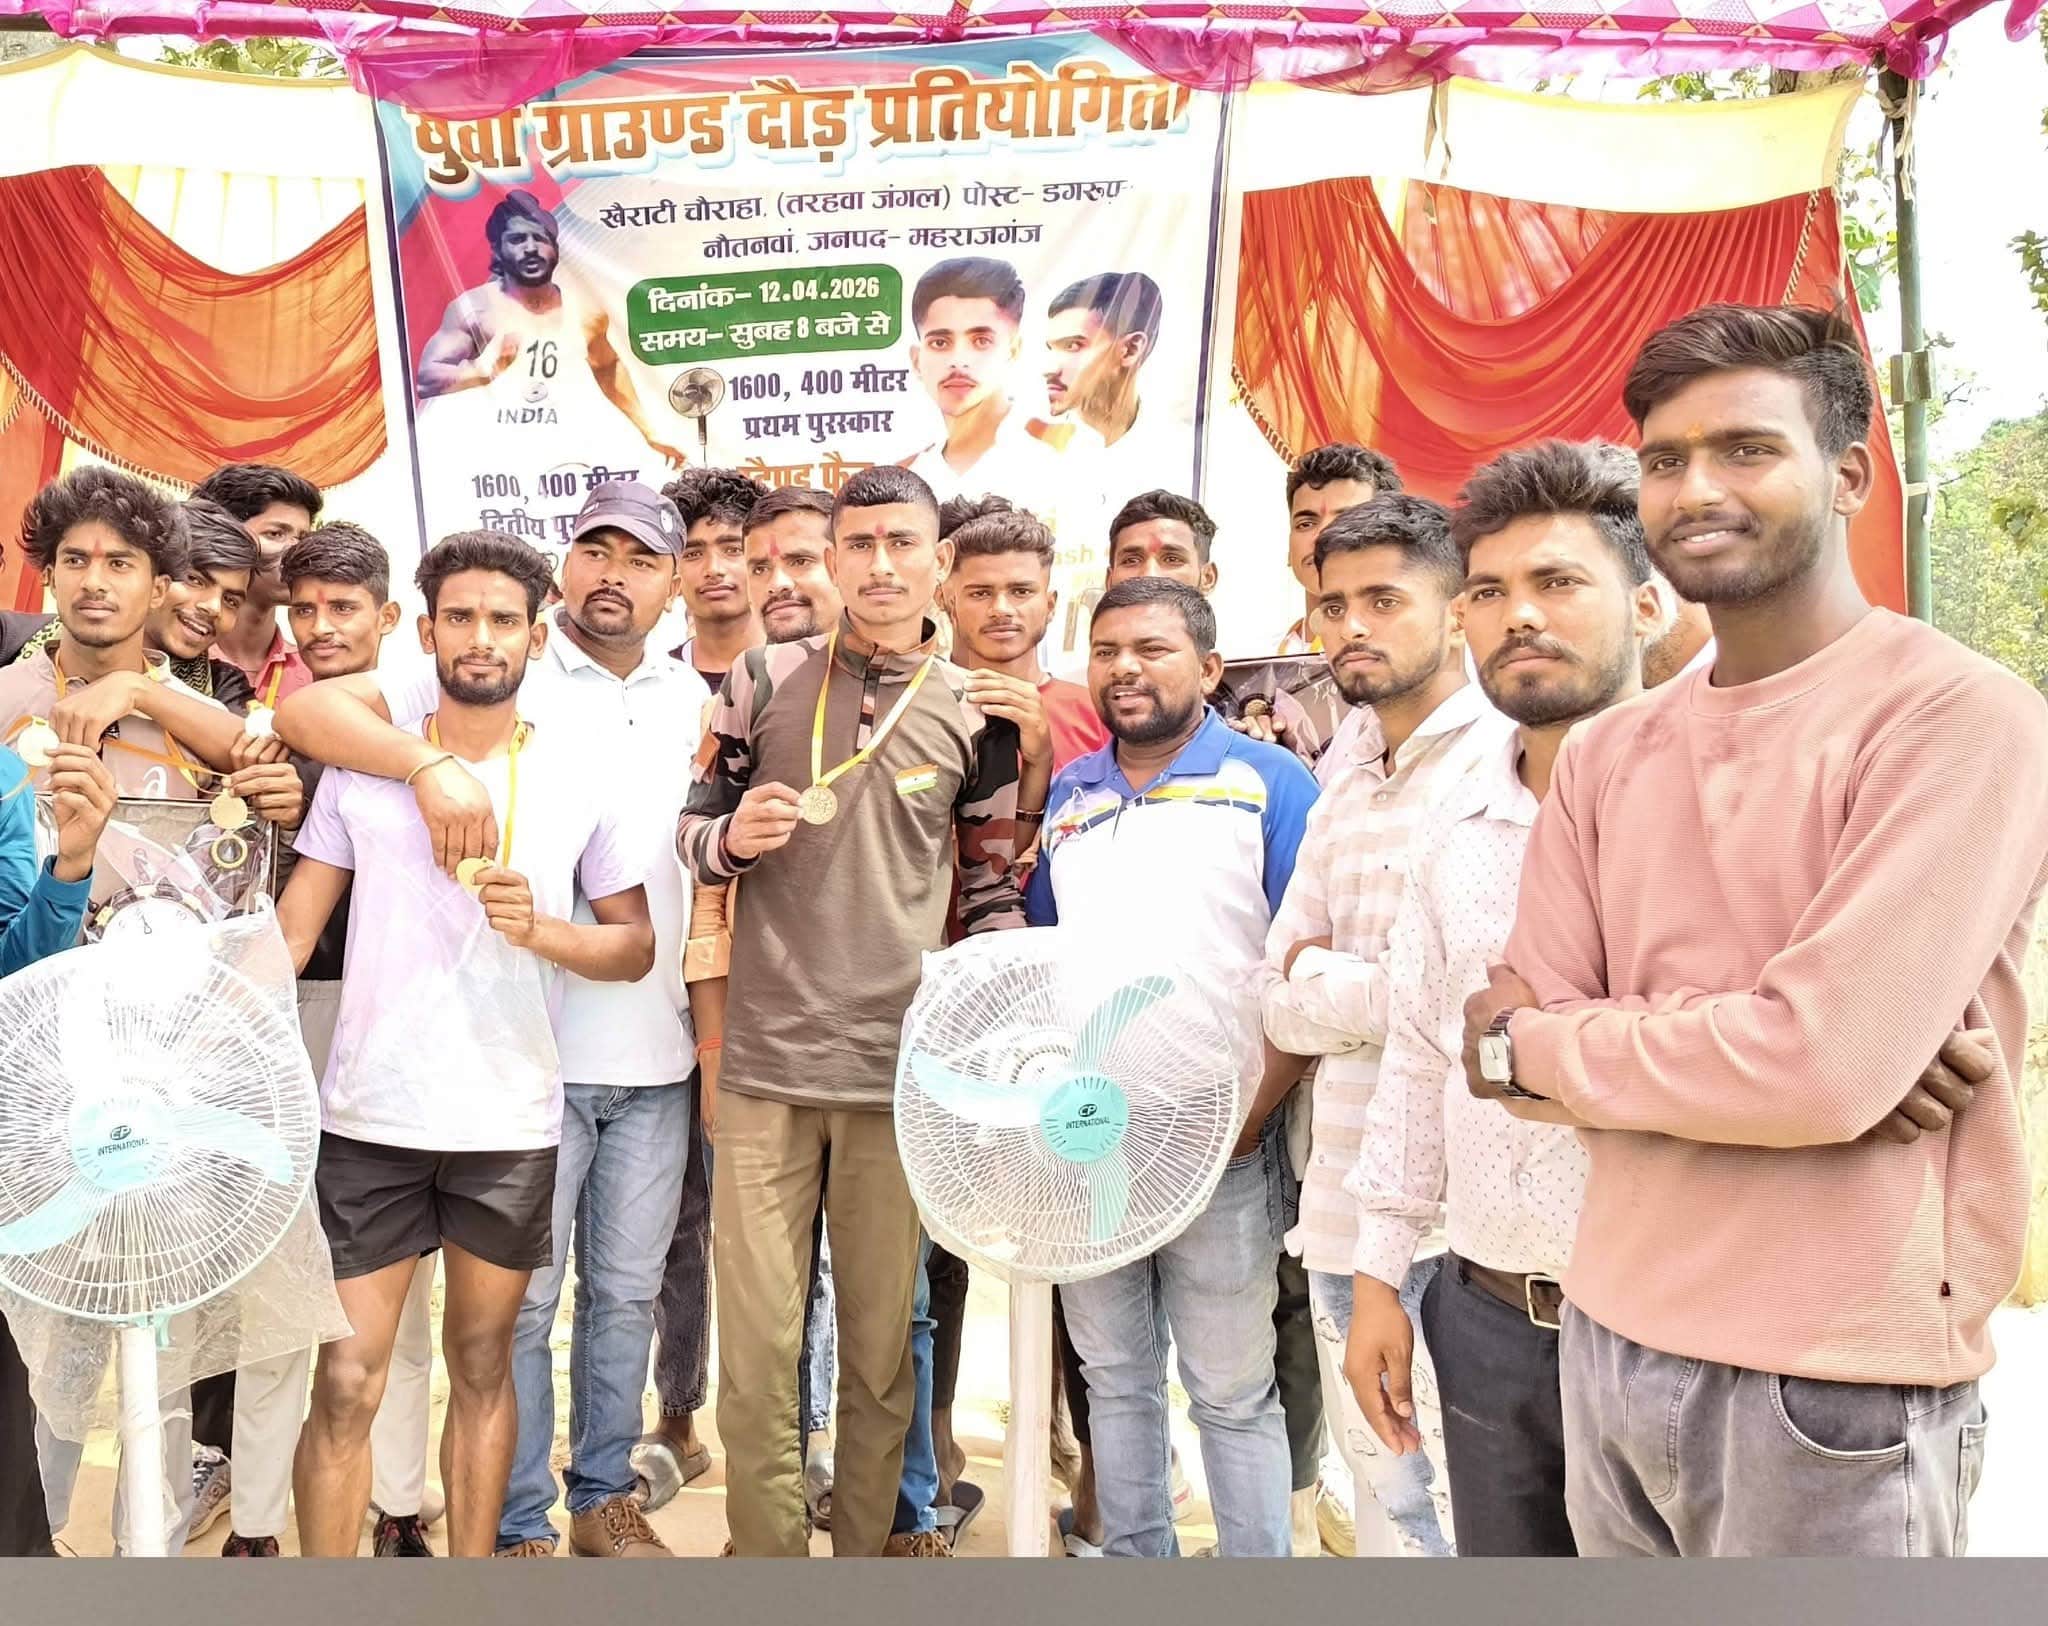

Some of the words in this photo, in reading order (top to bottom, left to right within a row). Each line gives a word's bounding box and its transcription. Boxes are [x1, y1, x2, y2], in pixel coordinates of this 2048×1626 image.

[406, 104, 521, 185] युवा
[533, 96, 729, 168] ग्राउण्ड
[740, 78, 855, 162] दौड़
[865, 61, 1191, 147] प्रतियोगिता
[600, 198, 677, 228] खैराटी
[777, 192, 865, 217] (तरहवा
[872, 184, 951, 210] जंगल)
[909, 218, 1044, 246] महराजगंज
[648, 282, 752, 313] दिनांक-
[758, 276, 881, 303] 12.04.2026
[639, 327, 724, 352] समय-
[728, 317, 794, 349] सुबह
[797, 316, 809, 339] 8
[815, 311, 861, 338] बजे
[865, 310, 892, 335] से
[526, 339, 558, 379] 16
[728, 372, 790, 402] 1600,
[801, 369, 842, 395] 400
[850, 364, 909, 393] मीटर
[496, 407, 559, 425] INDIA
[743, 414, 801, 440] प्रथम
[805, 410, 894, 443] पुरस्कार
[472, 473, 529, 504] 1600,
[538, 472, 577, 498] 400
[819, 451, 876, 498] फै
[1065, 1116, 1111, 1129] INTERNATIONAL
[97, 1138, 150, 1156] INTERNATIONAL
